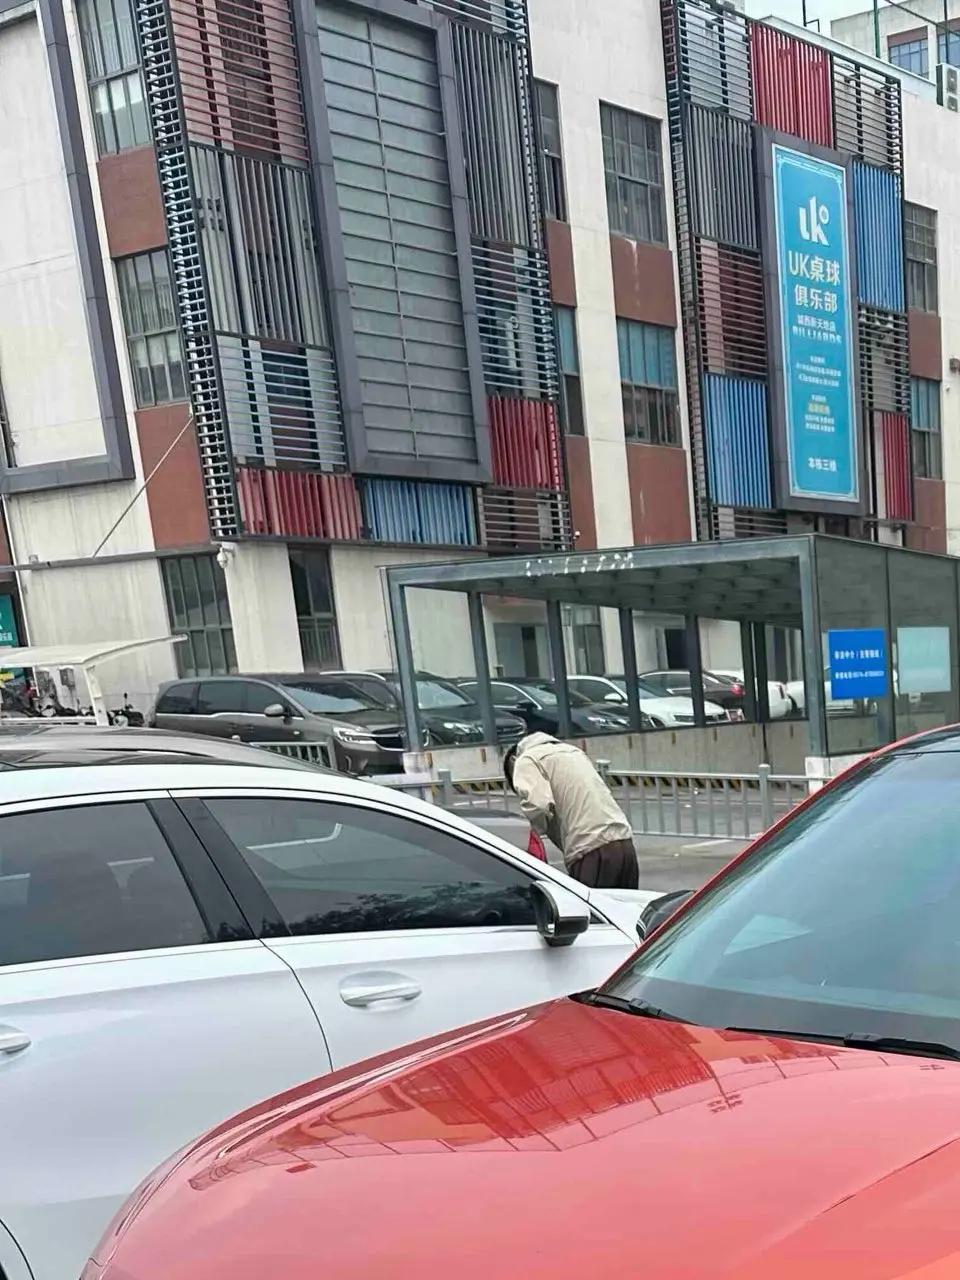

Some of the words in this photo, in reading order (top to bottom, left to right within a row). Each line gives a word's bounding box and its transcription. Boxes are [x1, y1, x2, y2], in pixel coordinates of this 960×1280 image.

[788, 250, 841, 287] UK桌球
[794, 283, 838, 314] 俱乐部
